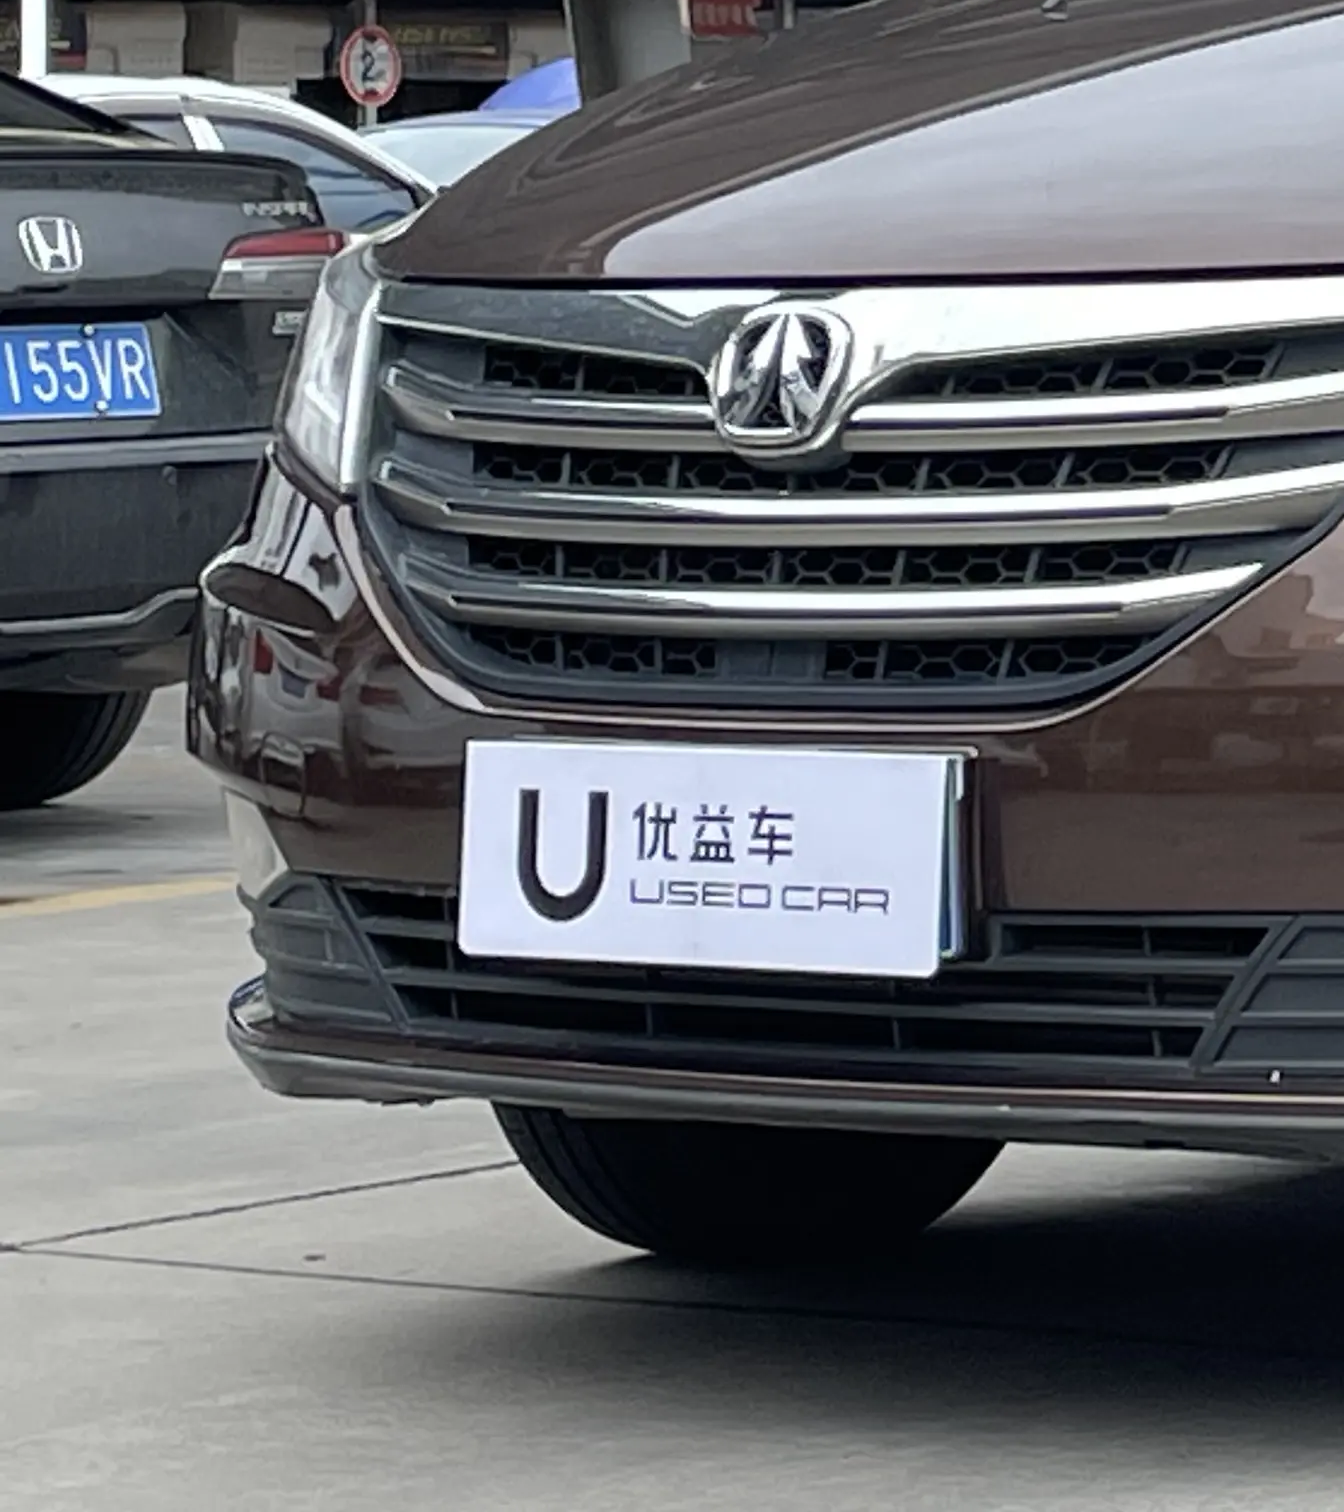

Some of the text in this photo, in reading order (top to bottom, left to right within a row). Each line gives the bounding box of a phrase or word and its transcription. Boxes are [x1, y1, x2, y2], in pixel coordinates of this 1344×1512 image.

[518, 788, 609, 921] U
[632, 802, 794, 865] 优益车
[630, 879, 889, 915] USED CAR
